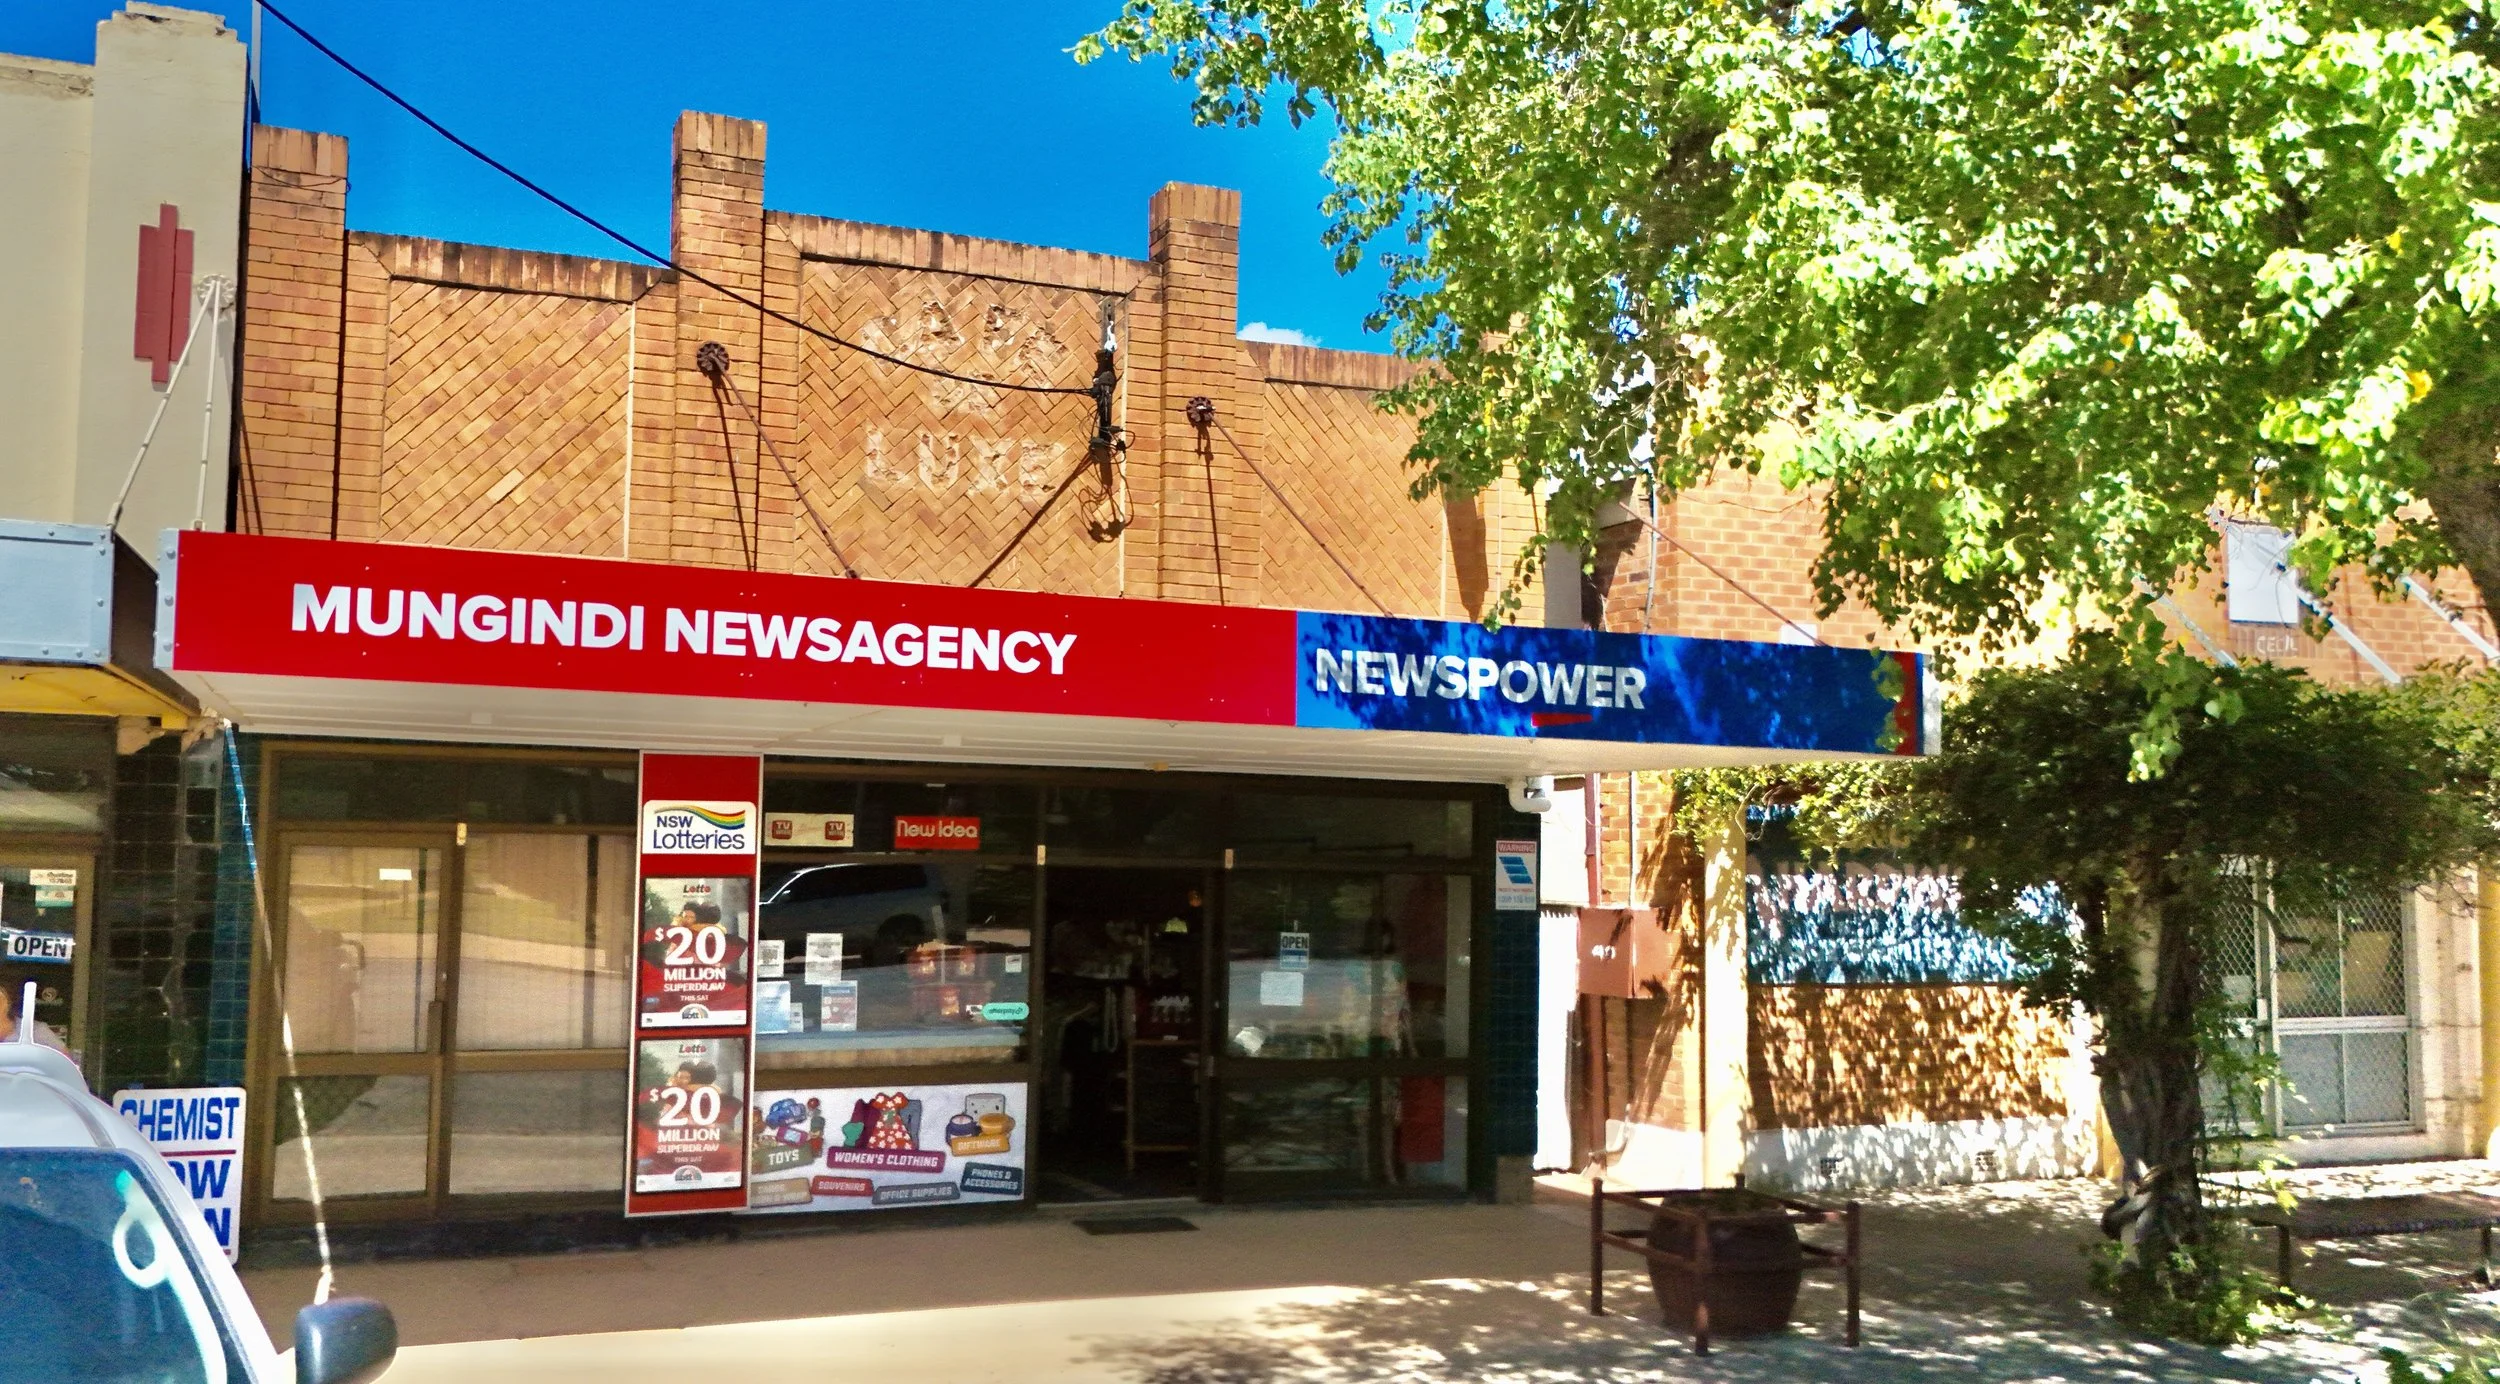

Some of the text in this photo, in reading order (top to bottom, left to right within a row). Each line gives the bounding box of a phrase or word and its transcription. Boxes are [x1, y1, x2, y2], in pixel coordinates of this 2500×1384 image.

[291, 583, 1078, 675] MUNGINDI NEWSAGENCY
[1316, 648, 1647, 710] NEWSPOWER
[656, 815, 693, 828] NSW
[938, 820, 978, 838] Idea
[653, 829, 745, 850] Lotteries
[683, 884, 712, 894] Lotto
[13, 936, 67, 957] OPEN
[655, 926, 726, 966] $20
[1282, 935, 1308, 949] OPEN
[664, 967, 726, 982] MILLION
[663, 982, 726, 992] SUPERDRAW
[678, 1043, 707, 1054] Lotto
[650, 1086, 721, 1127] $20
[658, 1128, 720, 1143] MILLION
[657, 1143, 720, 1154] SUPERDRAW
[768, 1149, 800, 1166] TOYS
[835, 1151, 938, 1167] WOMEN'S CLOTHING
[971, 1168, 1003, 1179] PHONES
[818, 1181, 866, 1191] SOUVENIRS
[964, 1179, 1019, 1190] ACCESSORIES
[880, 1186, 952, 1200] OFFICE SUPPLIES
